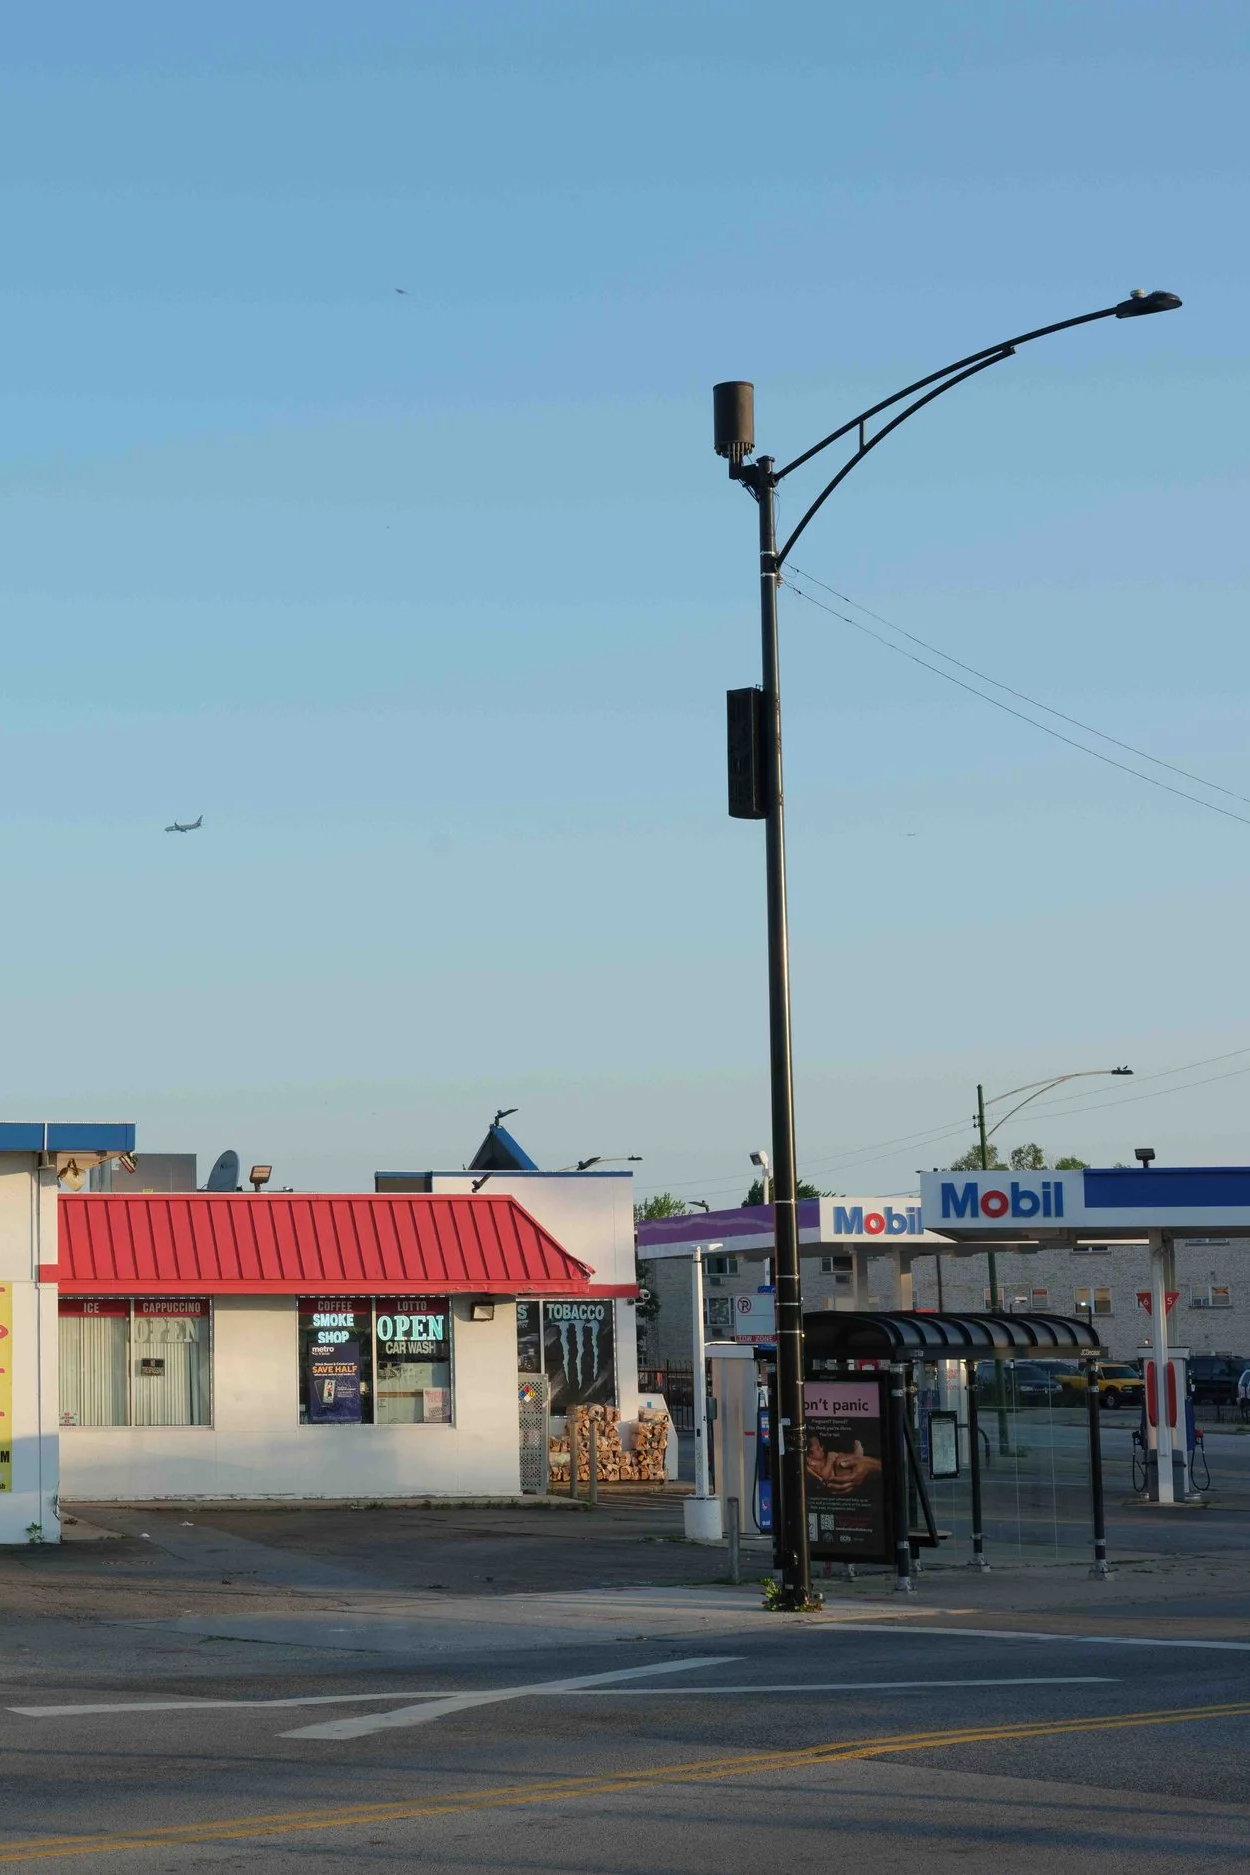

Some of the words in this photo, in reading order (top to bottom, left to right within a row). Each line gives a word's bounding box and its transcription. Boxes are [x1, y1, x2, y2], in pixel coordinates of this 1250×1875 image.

[941, 1181, 1064, 1219] Mobil
[833, 1206, 923, 1235] Mobil
[318, 1300, 353, 1312] COFFEE
[397, 1300, 427, 1312] LOTTO
[1143, 1297, 1149, 1306] 6
[1167, 1296, 1172, 1305] 5
[83, 1302, 99, 1314] ICE
[142, 1302, 201, 1313] CAPPUCCINO
[546, 1303, 605, 1320] TOBACCO
[312, 1313, 355, 1327] SMOKE
[135, 1317, 199, 1344] OPEN
[376, 1315, 444, 1341] OPEN
[317, 1330, 350, 1344] SHOP
[312, 1345, 335, 1353] metro
[385, 1341, 407, 1354] CAR
[408, 1341, 436, 1354] WASH
[312, 1365, 334, 1373] SAVE
[335, 1365, 358, 1373] HALF
[804, 1397, 829, 1411] on't
[833, 1398, 869, 1414] panic
